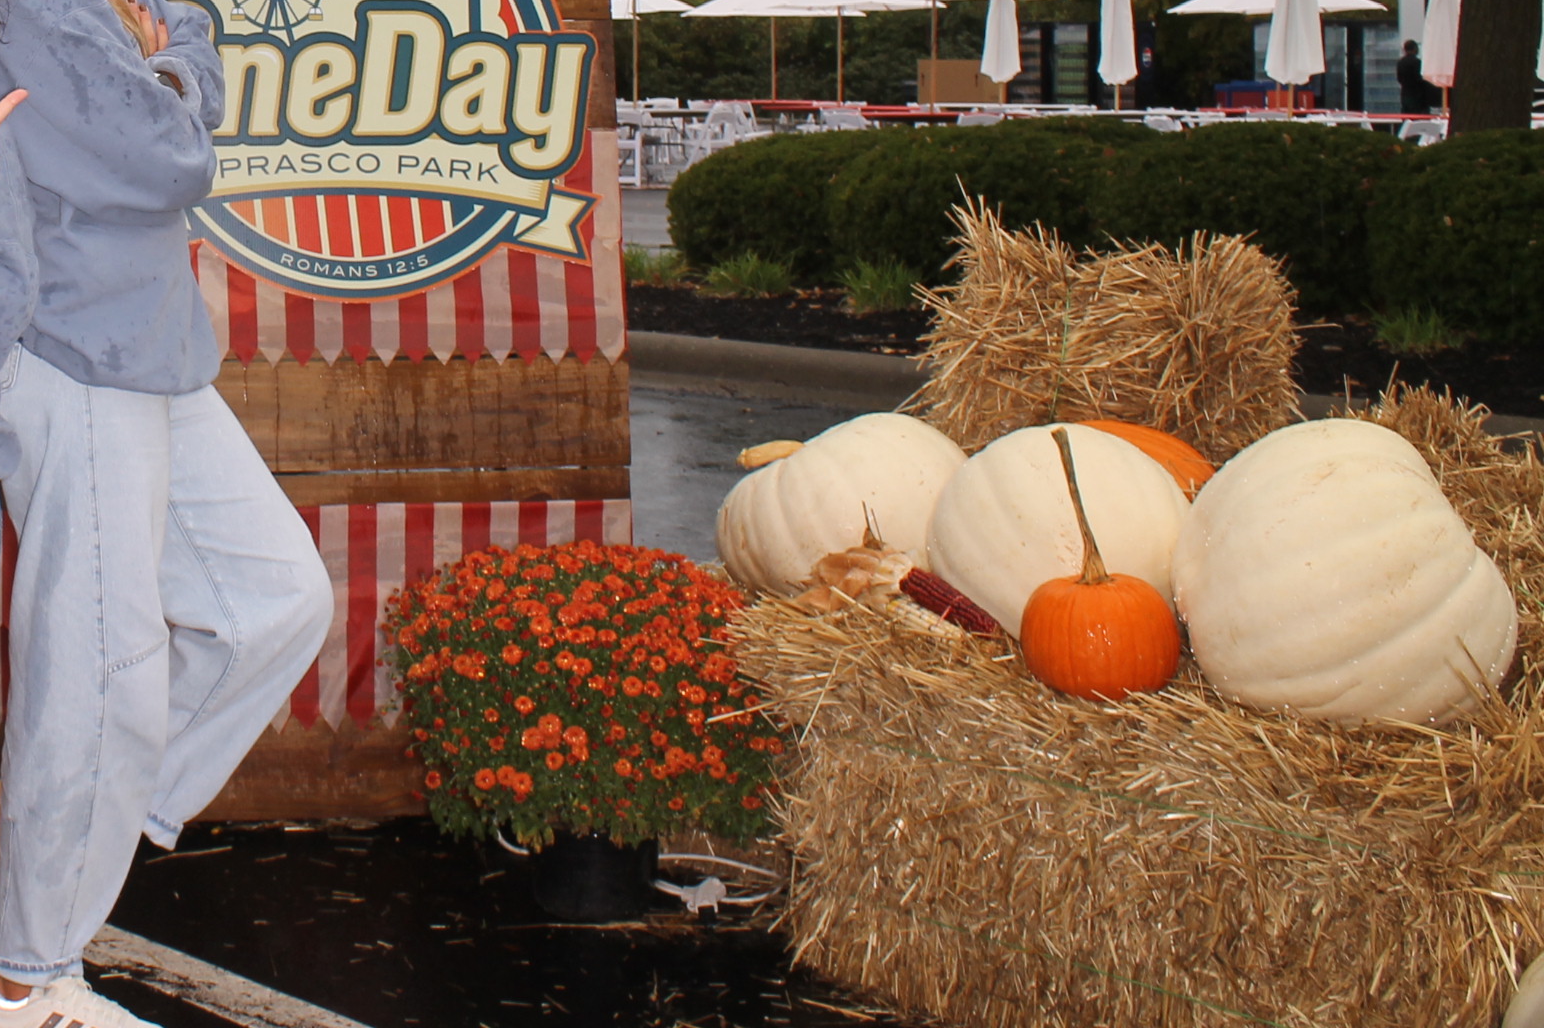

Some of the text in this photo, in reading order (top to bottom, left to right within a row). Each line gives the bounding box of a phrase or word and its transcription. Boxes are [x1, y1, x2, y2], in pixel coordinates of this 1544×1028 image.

[219, 153, 500, 184] PRASCO PARK
[280, 252, 430, 278] ROMANS 12:5
